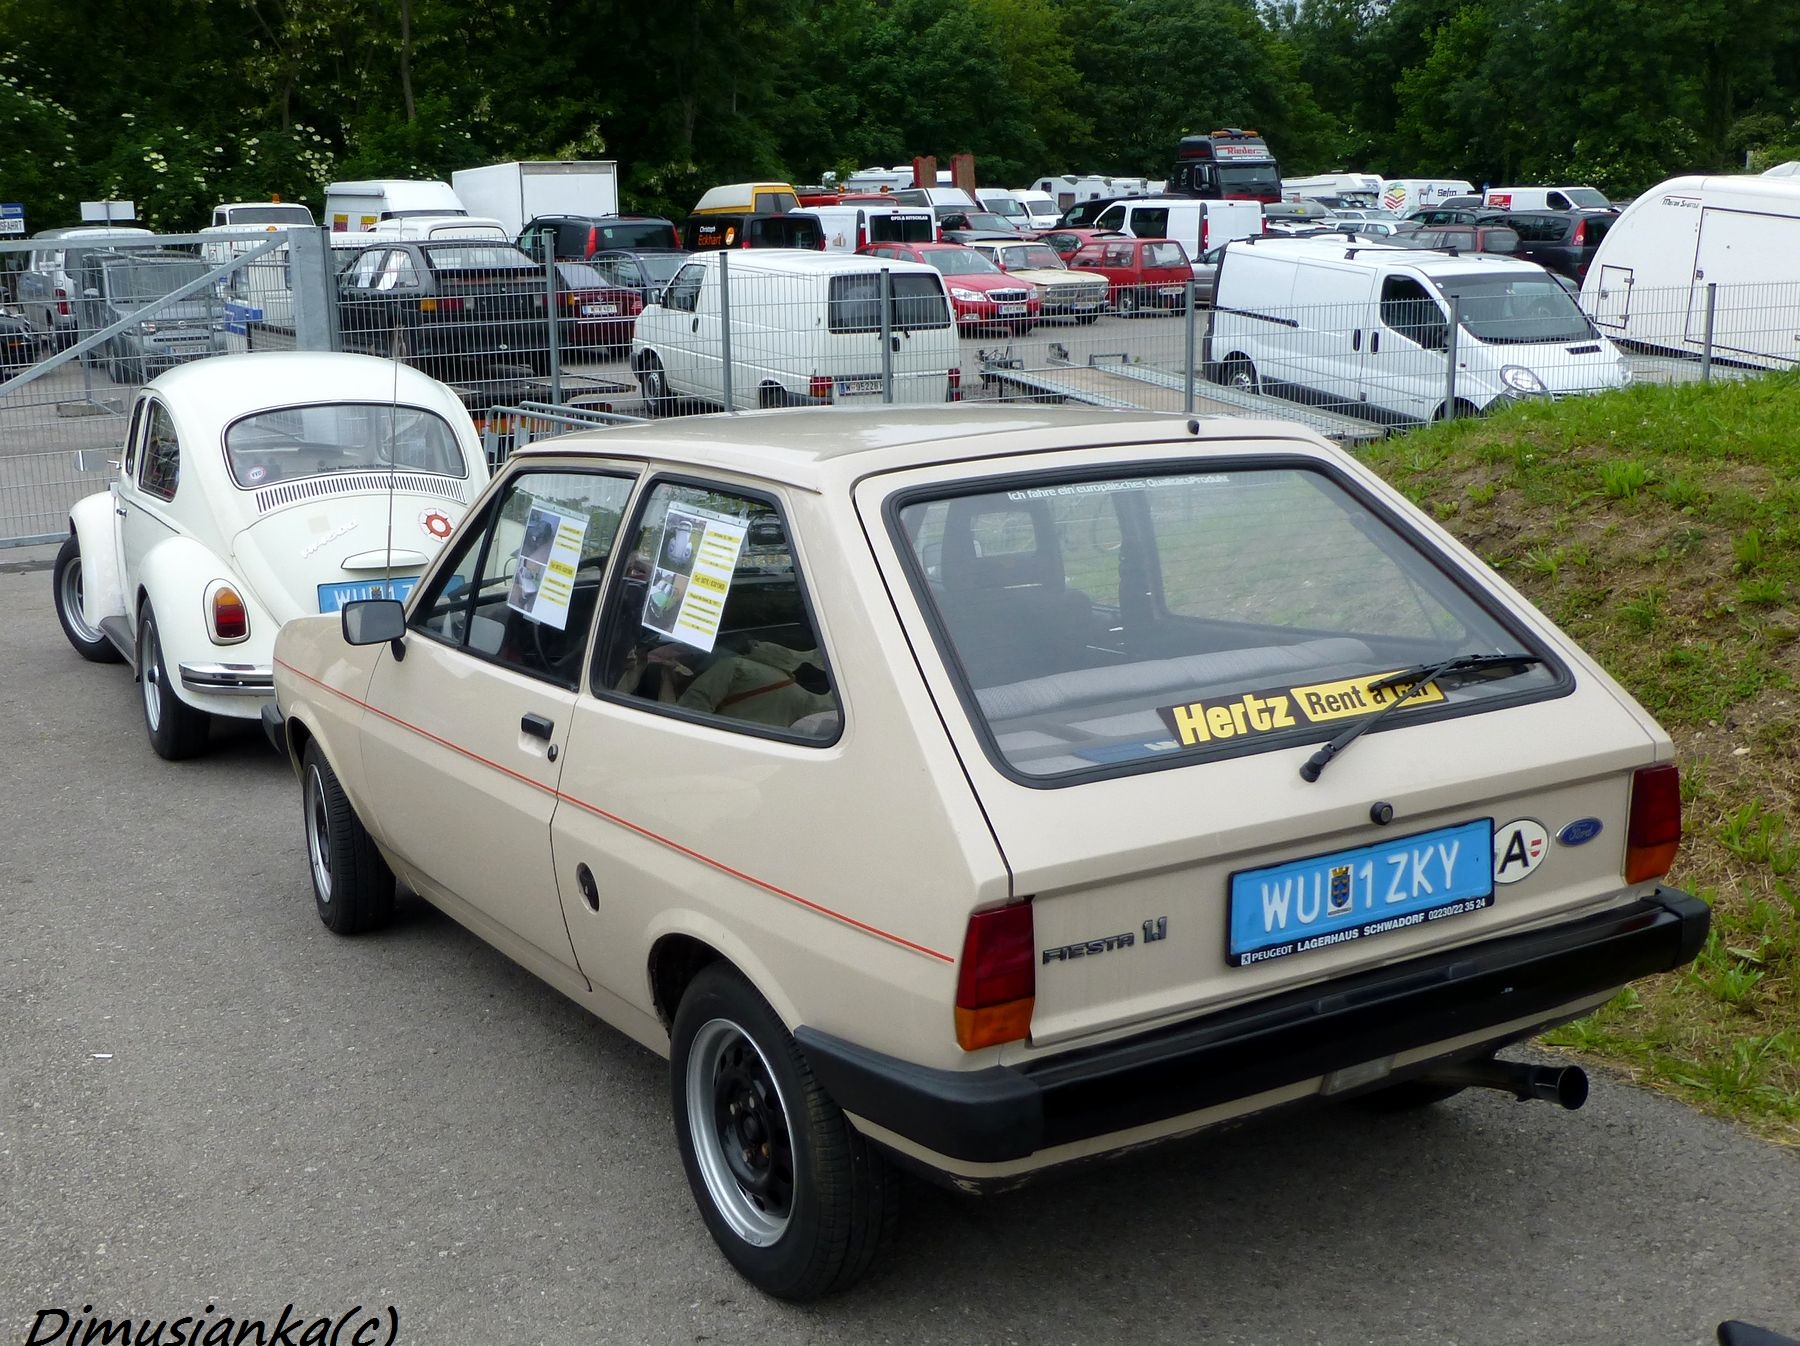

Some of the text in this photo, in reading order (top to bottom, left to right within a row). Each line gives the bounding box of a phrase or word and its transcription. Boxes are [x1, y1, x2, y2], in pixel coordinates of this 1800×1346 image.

[1227, 146, 1256, 154] Rieder
[1007, 491, 1026, 501] Ich
[1027, 489, 1057, 499] fahre
[1057, 486, 1075, 496] ein
[1173, 694, 1296, 746] Hertz
[1305, 685, 1367, 715] Rent
[1370, 687, 1388, 705] a
[1498, 829, 1529, 874] A
[1261, 872, 1321, 933] WU
[1042, 931, 1135, 965] FIESTA
[1251, 898, 1486, 962] PEUGEOT LAGERHAUS SCHWADORF 02230/22 35 24
